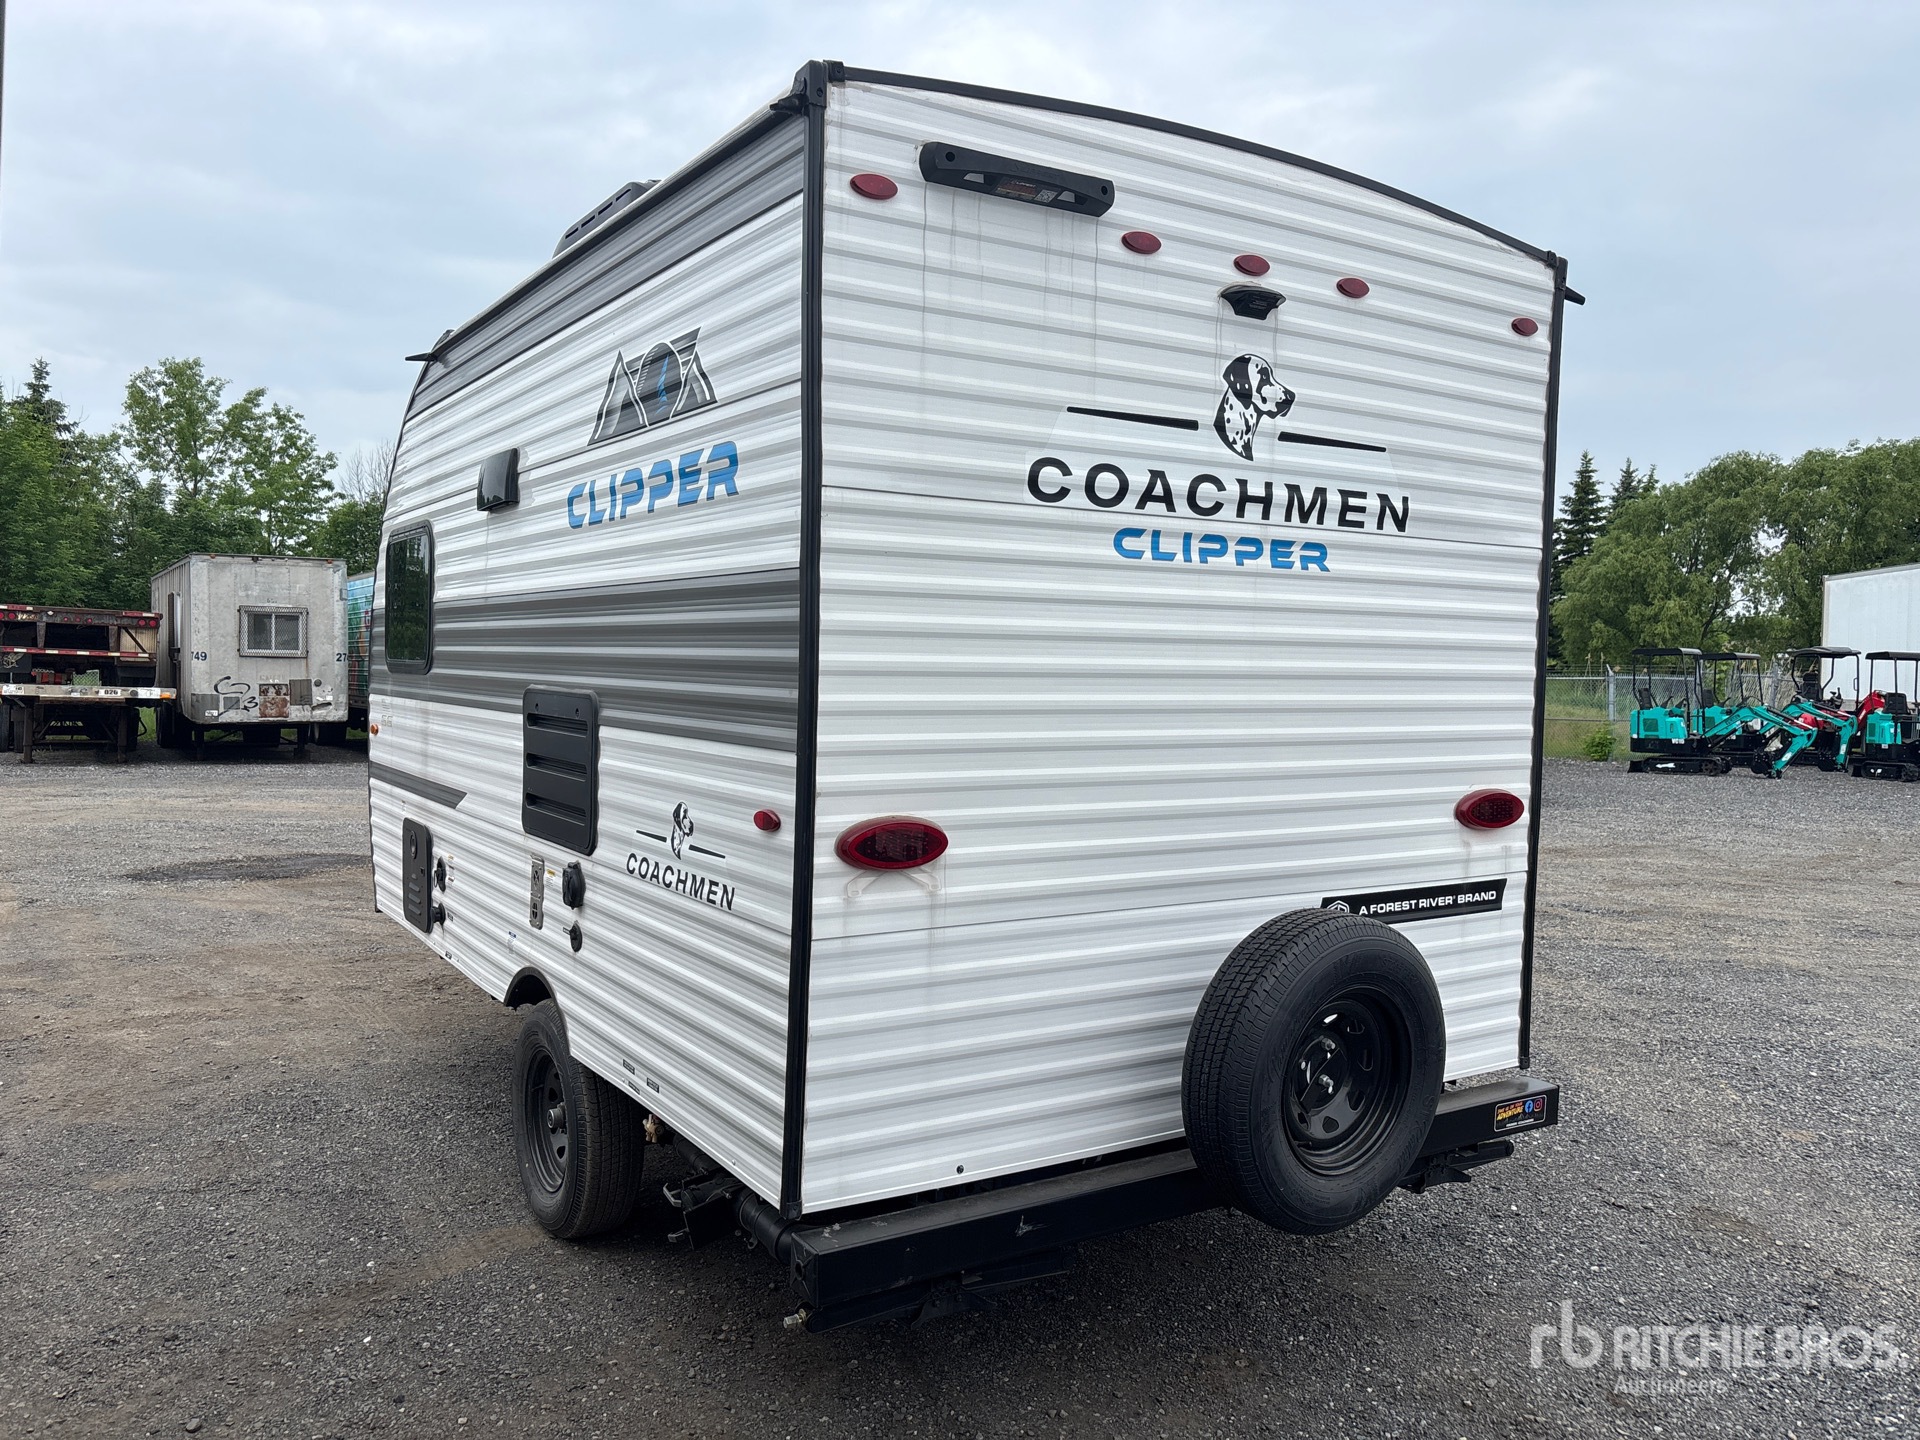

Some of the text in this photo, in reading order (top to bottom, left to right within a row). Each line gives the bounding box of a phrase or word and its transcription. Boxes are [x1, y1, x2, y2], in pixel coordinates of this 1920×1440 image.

[567, 441, 740, 530] CLIPPER
[1026, 456, 1410, 533] COACHMEN
[1113, 527, 1331, 573] CLIPPER
[626, 852, 736, 912] COACHMEN
[1358, 904, 1369, 916] A
[1370, 900, 1417, 914] FOREST
[1457, 890, 1497, 904] BRAND
